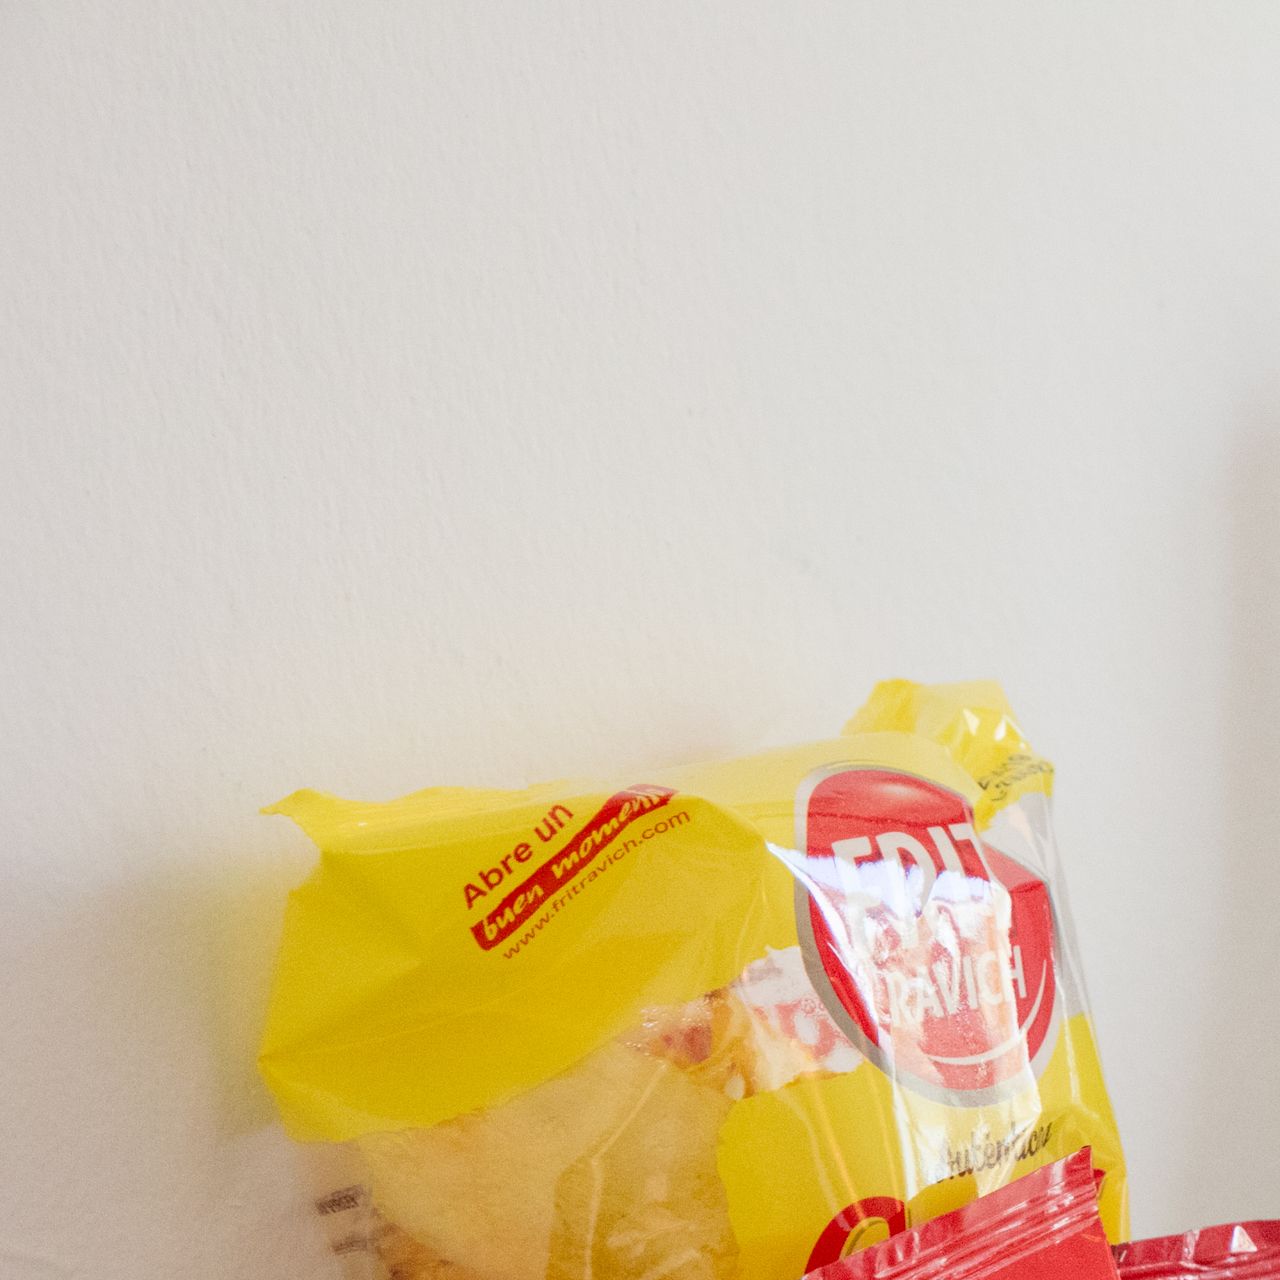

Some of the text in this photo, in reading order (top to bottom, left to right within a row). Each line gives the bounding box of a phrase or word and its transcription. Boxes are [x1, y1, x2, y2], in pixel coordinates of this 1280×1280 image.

[462, 803, 575, 911] Abre un
[481, 884, 545, 938] buen
[502, 809, 692, 961] www.fritravich.com
